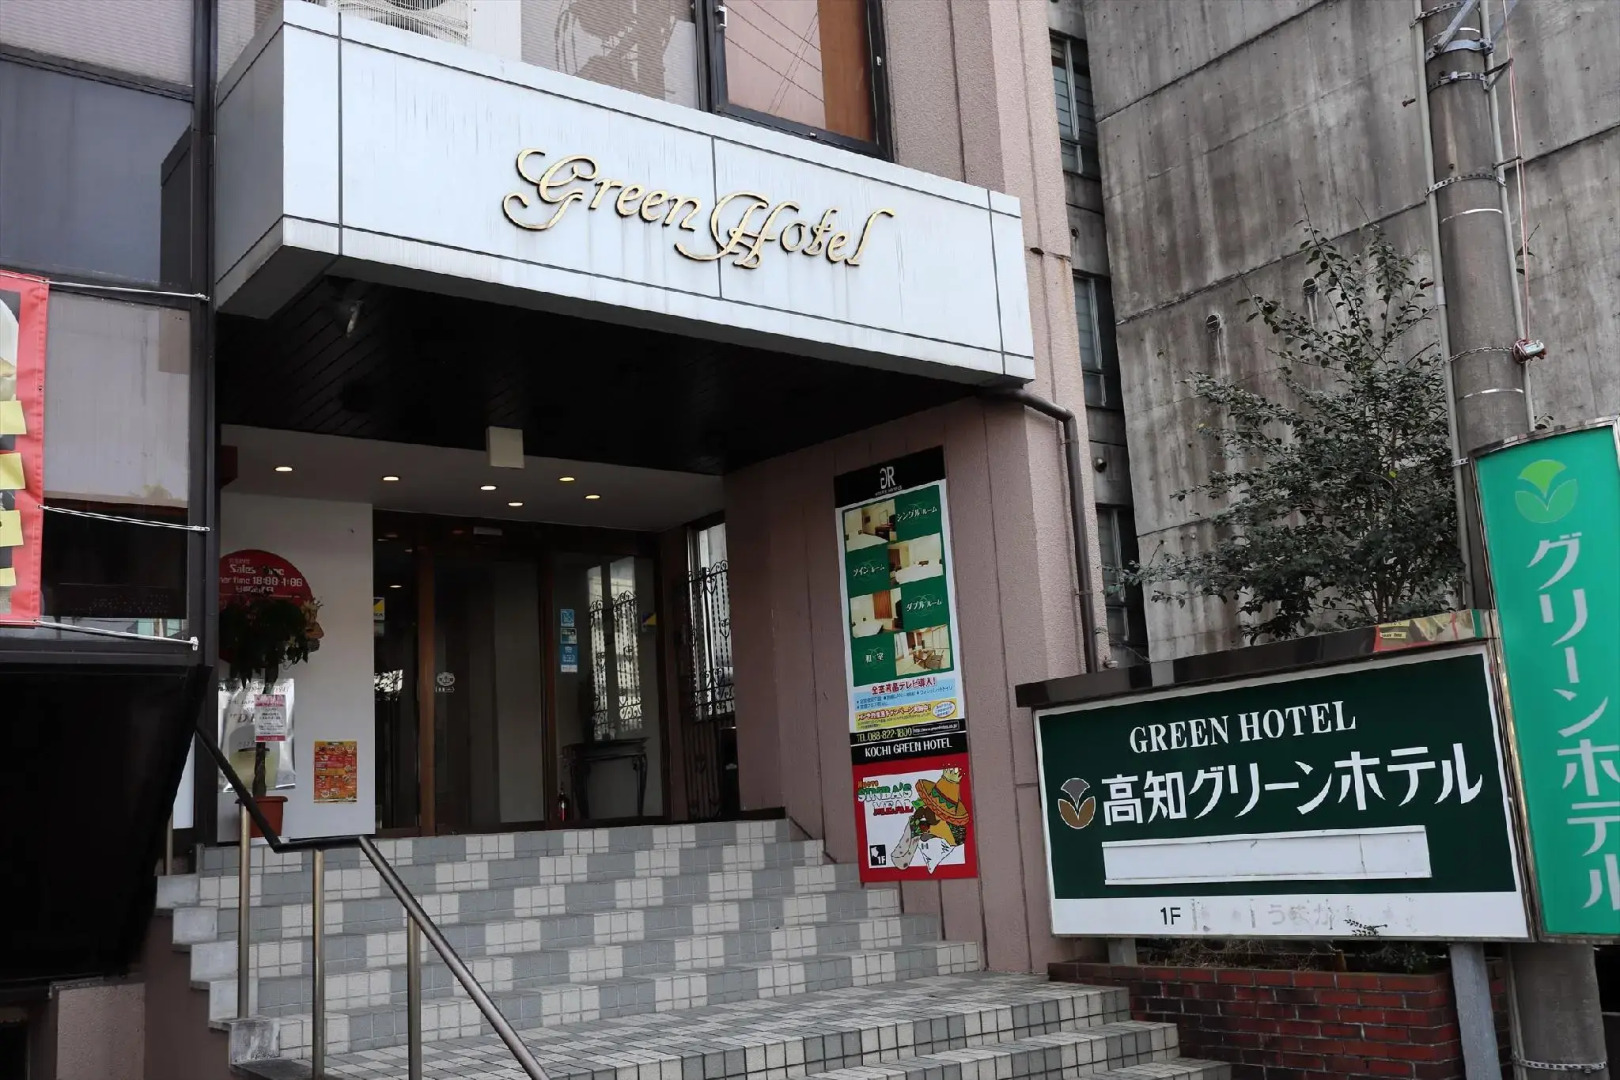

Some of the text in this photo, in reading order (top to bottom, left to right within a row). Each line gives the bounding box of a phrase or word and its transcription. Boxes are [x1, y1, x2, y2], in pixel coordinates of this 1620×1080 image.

[502, 148, 896, 270] Green Hotel
[864, 737, 953, 758] KOCHI GREEN HOTEL
[1128, 700, 1357, 755] GREEN HOTEL
[1526, 531, 1620, 911] グリーンホテル
[1101, 742, 1485, 828] 高知グリーンホテル
[877, 856, 886, 865] 1F
[1160, 906, 1182, 926] 1F
